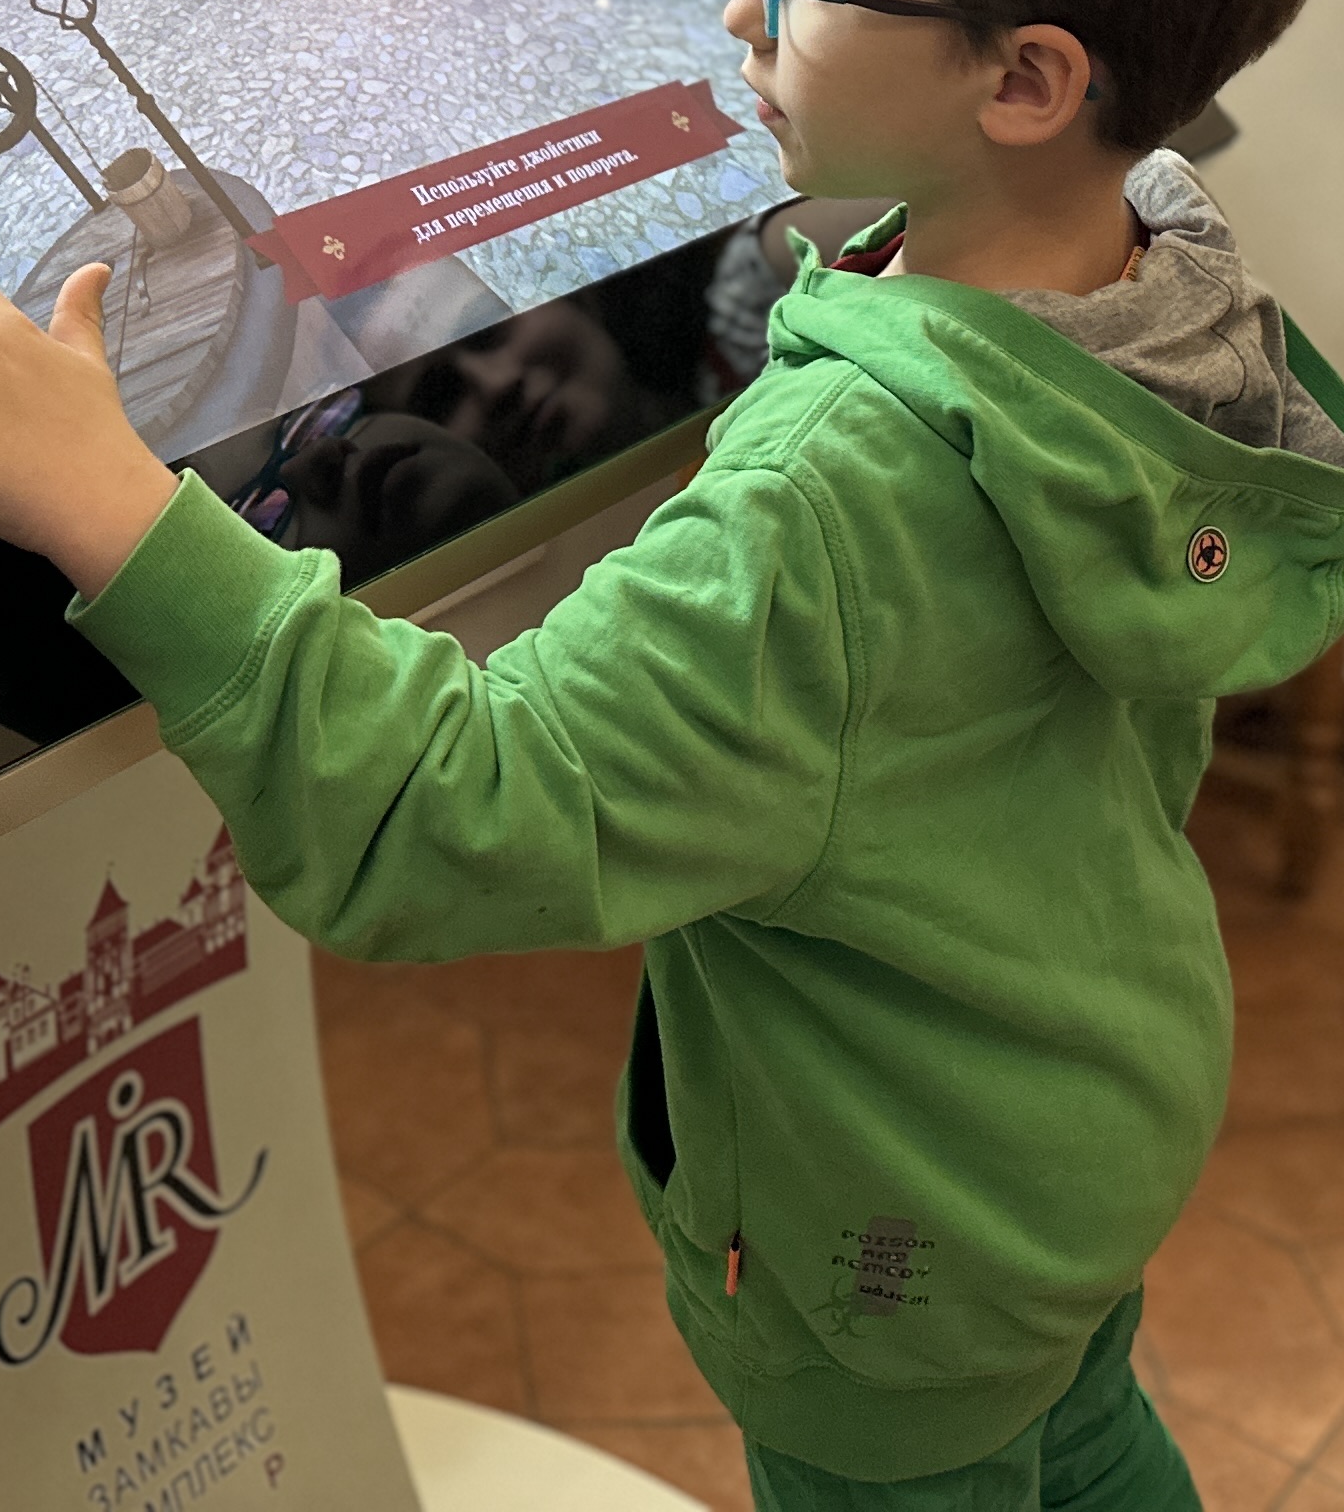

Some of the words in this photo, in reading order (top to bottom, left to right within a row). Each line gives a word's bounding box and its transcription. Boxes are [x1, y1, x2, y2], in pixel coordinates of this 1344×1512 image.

[410, 159, 520, 207] Используйте
[518, 129, 603, 171] джойстики
[412, 218, 446, 245] для
[444, 179, 554, 227] перемещения
[552, 172, 569, 189] и
[565, 147, 640, 183] поворота.
